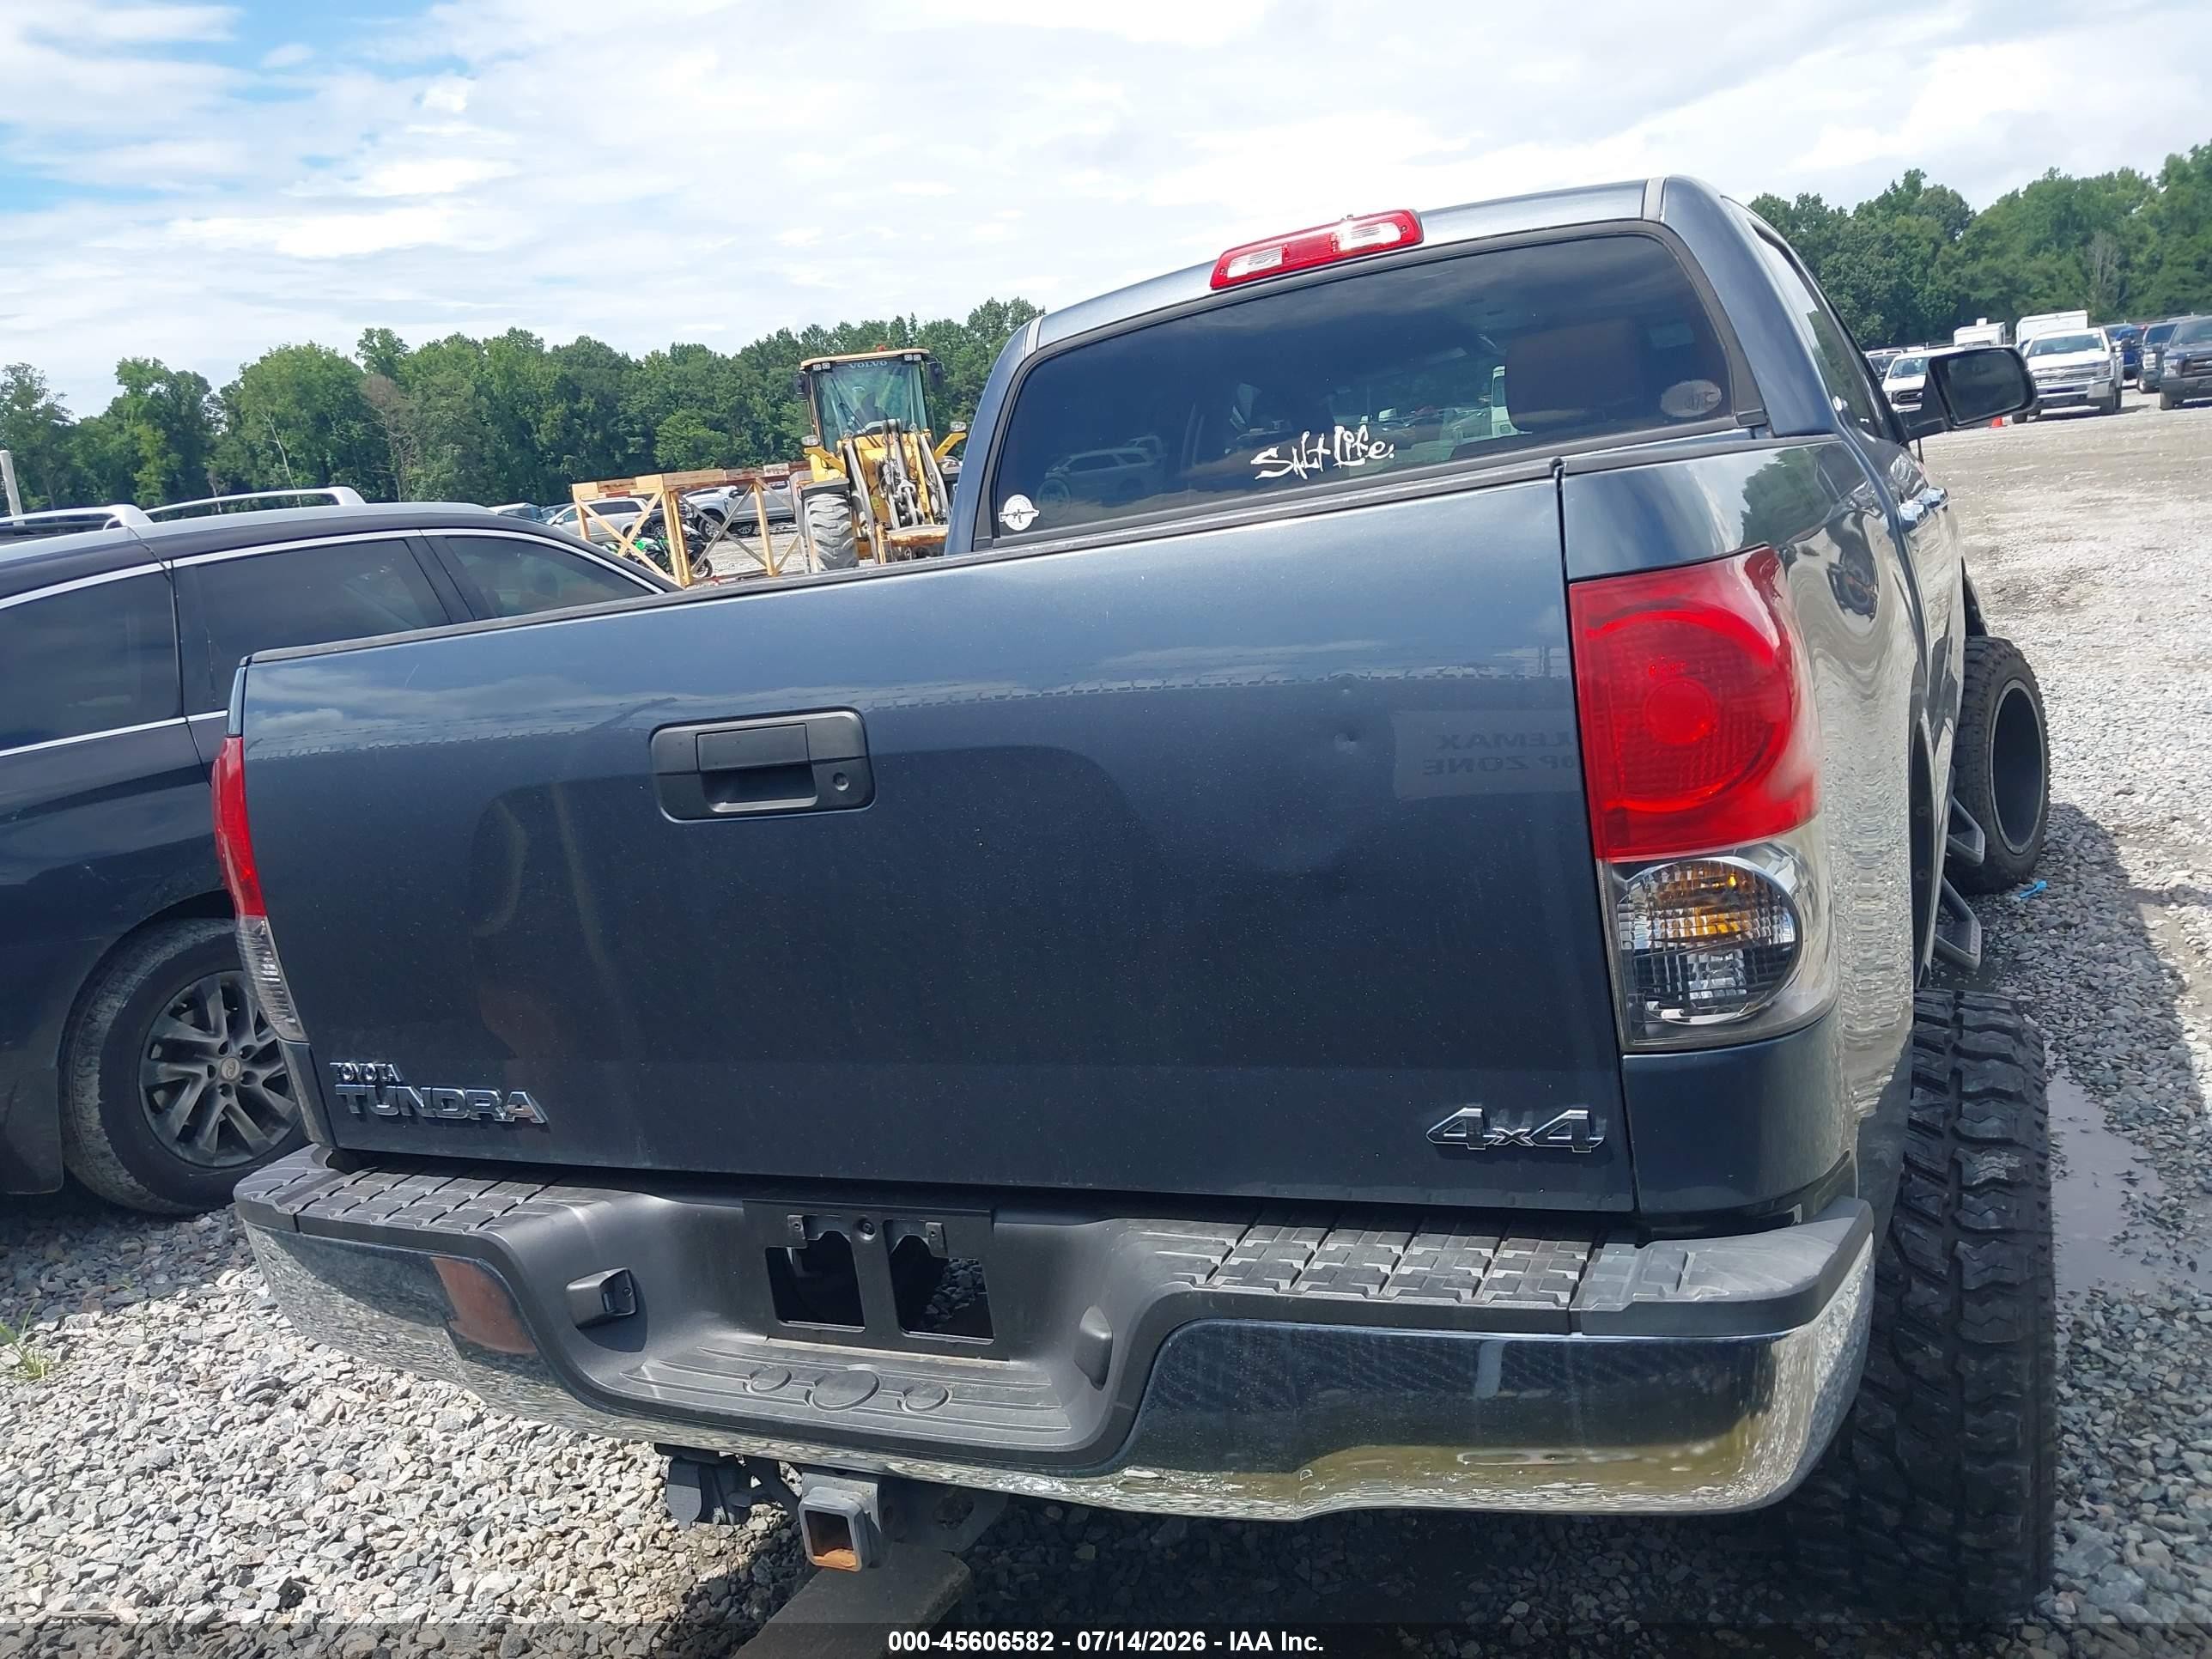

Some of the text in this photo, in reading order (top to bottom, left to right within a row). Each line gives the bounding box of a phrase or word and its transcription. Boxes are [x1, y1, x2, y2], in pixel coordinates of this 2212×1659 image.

[848, 360, 888, 369] VOLVO
[334, 1084, 549, 1125] TUNDRA
[1425, 1107, 1605, 1153] 4x4
